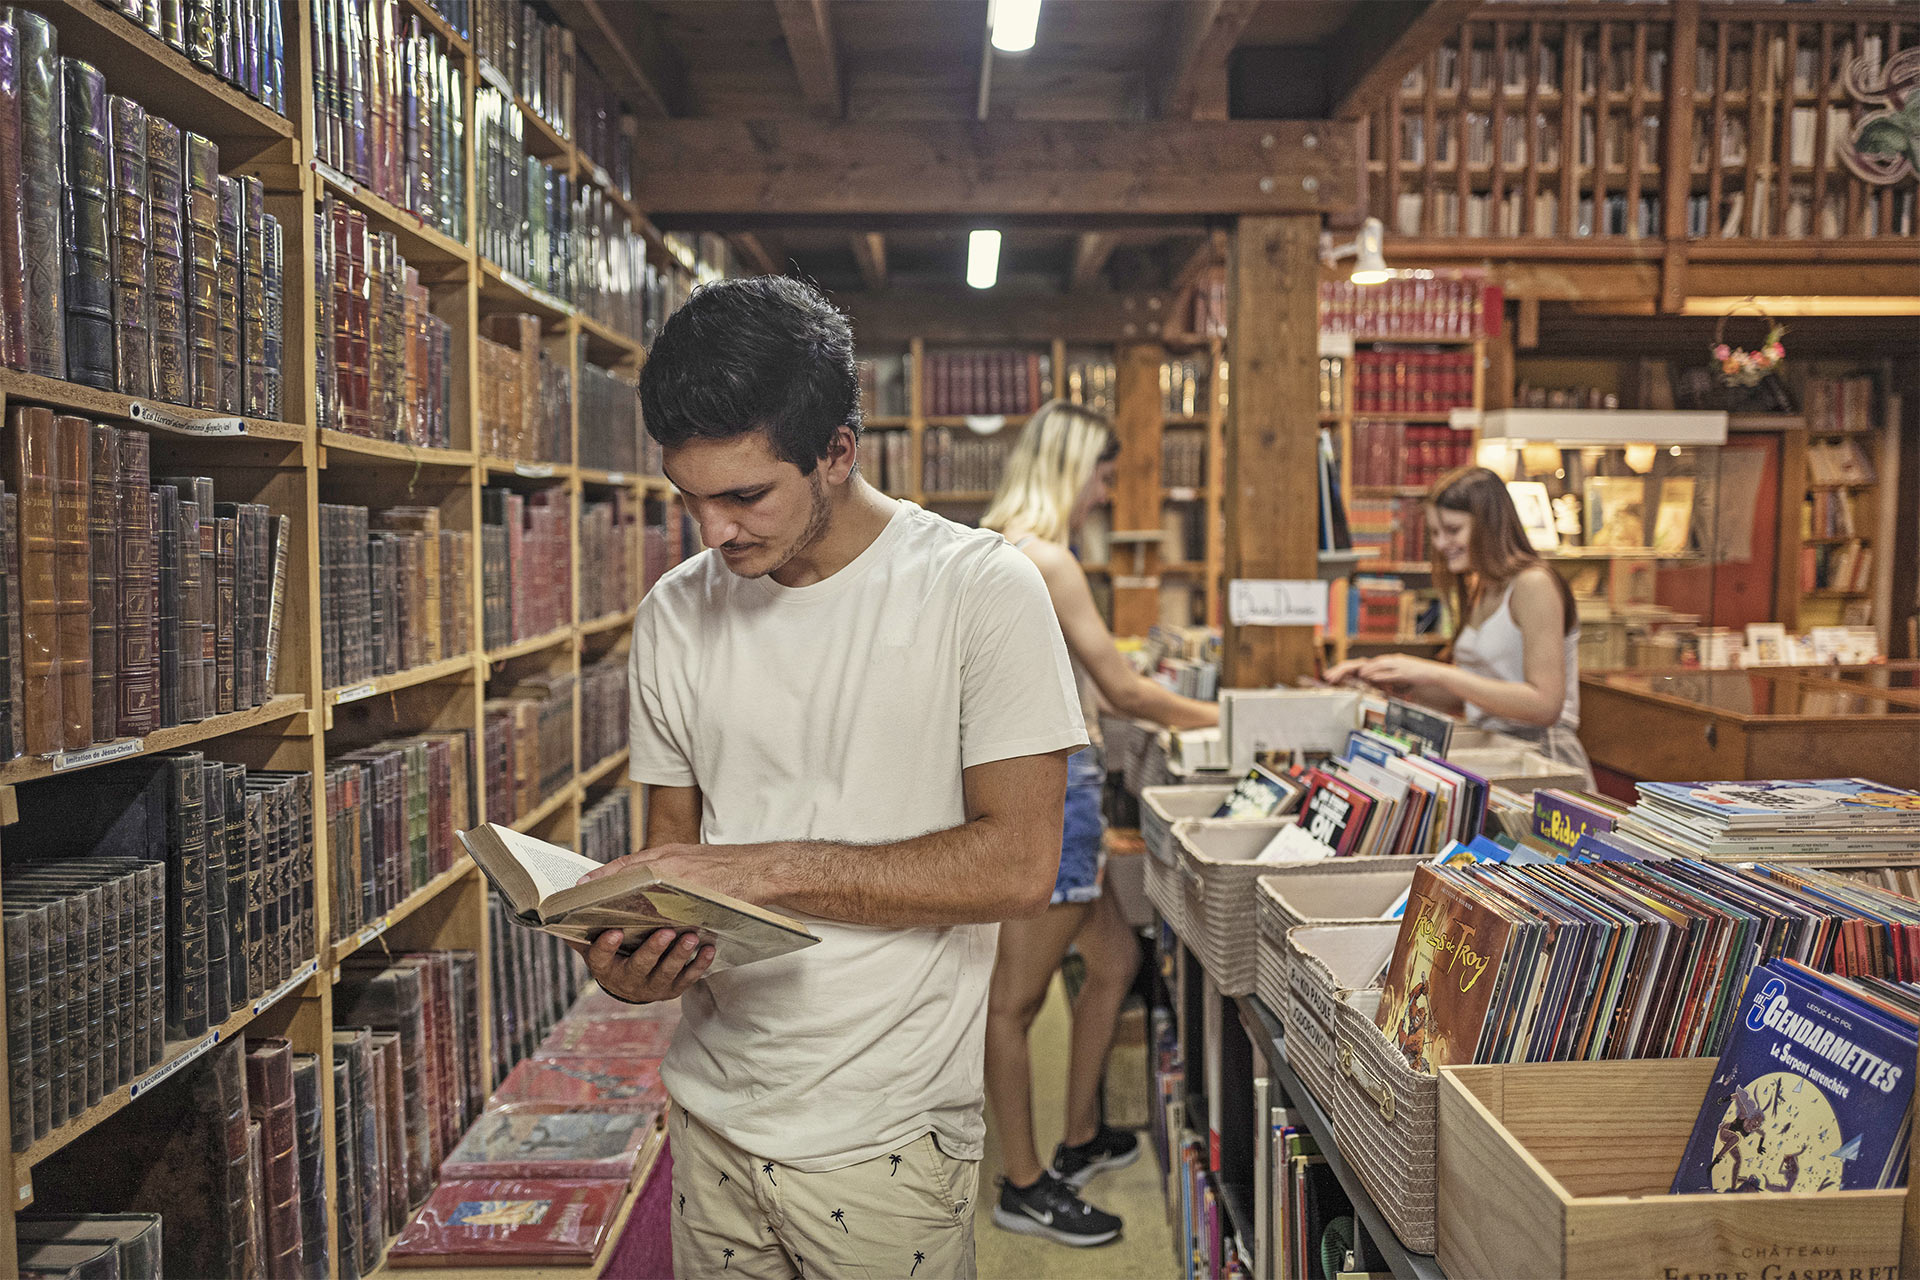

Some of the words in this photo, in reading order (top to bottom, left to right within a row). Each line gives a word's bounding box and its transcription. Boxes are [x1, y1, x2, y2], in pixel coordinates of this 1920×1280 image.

[65, 752, 92, 764] Imitation
[93, 751, 100, 759] de
[101, 744, 133, 757] Jésus-Christ
[1310, 987, 1331, 1022] PADDLE
[1746, 977, 1787, 1031] 3
[1753, 992, 1765, 1005] LES
[1806, 1002, 1826, 1017] LEDUC
[1831, 1015, 1841, 1023] JC
[1841, 1020, 1853, 1031] POL
[1762, 994, 1902, 1092] GENDARMETTES
[1770, 1042, 1780, 1058] Le
[1779, 1043, 1810, 1076] Serpent
[1808, 1066, 1850, 1099] surenchère
[1741, 1243, 1837, 1259] CHÂTEAU
